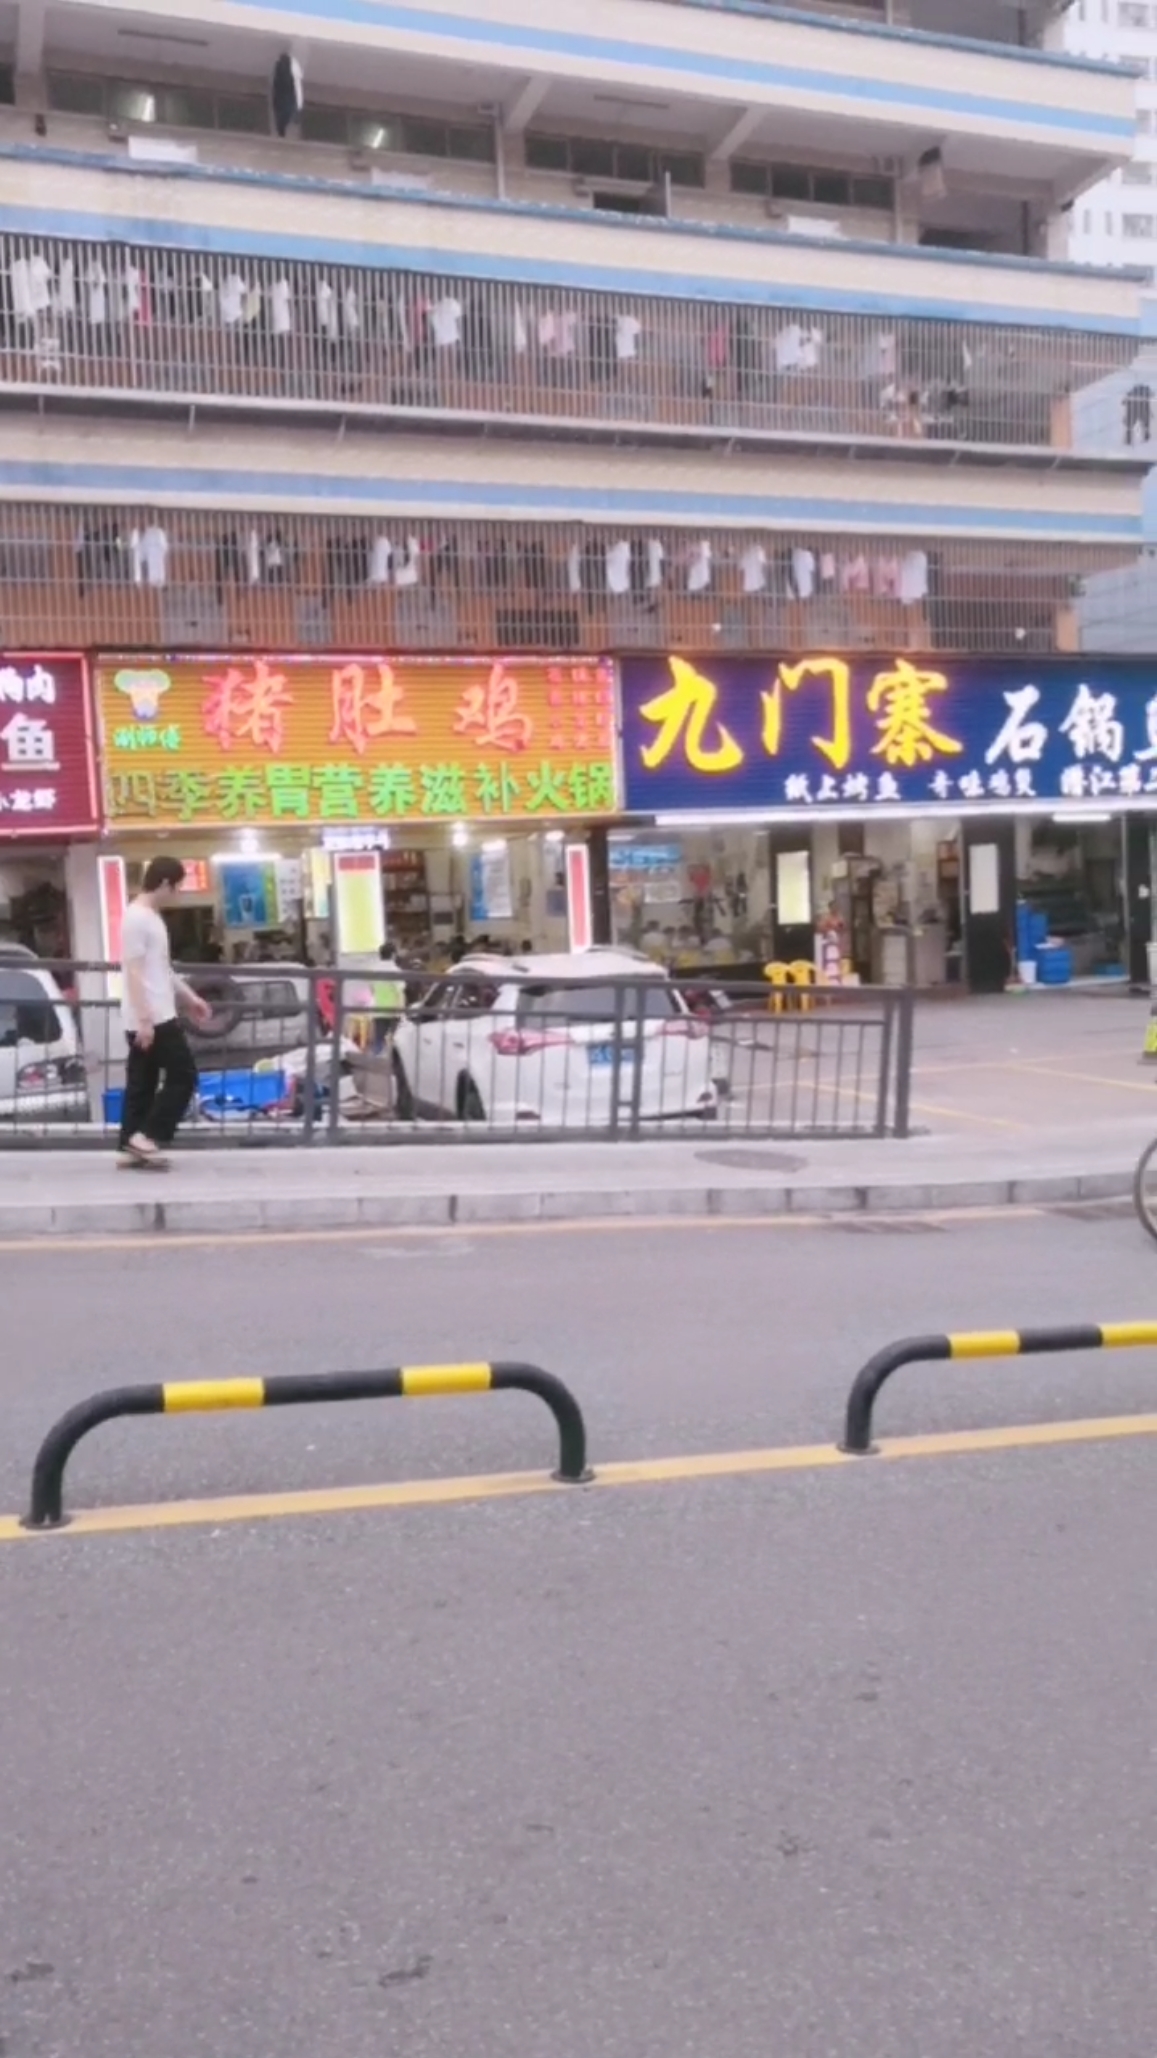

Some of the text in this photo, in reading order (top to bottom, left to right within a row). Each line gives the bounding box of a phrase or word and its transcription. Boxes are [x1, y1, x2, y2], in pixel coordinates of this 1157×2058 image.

[0, 712, 60, 771] 鱼
[201, 660, 532, 754] 猪肚鸡
[640, 655, 964, 772] 九门寨
[107, 760, 615, 822] 四季养胃营养滋补火锅
